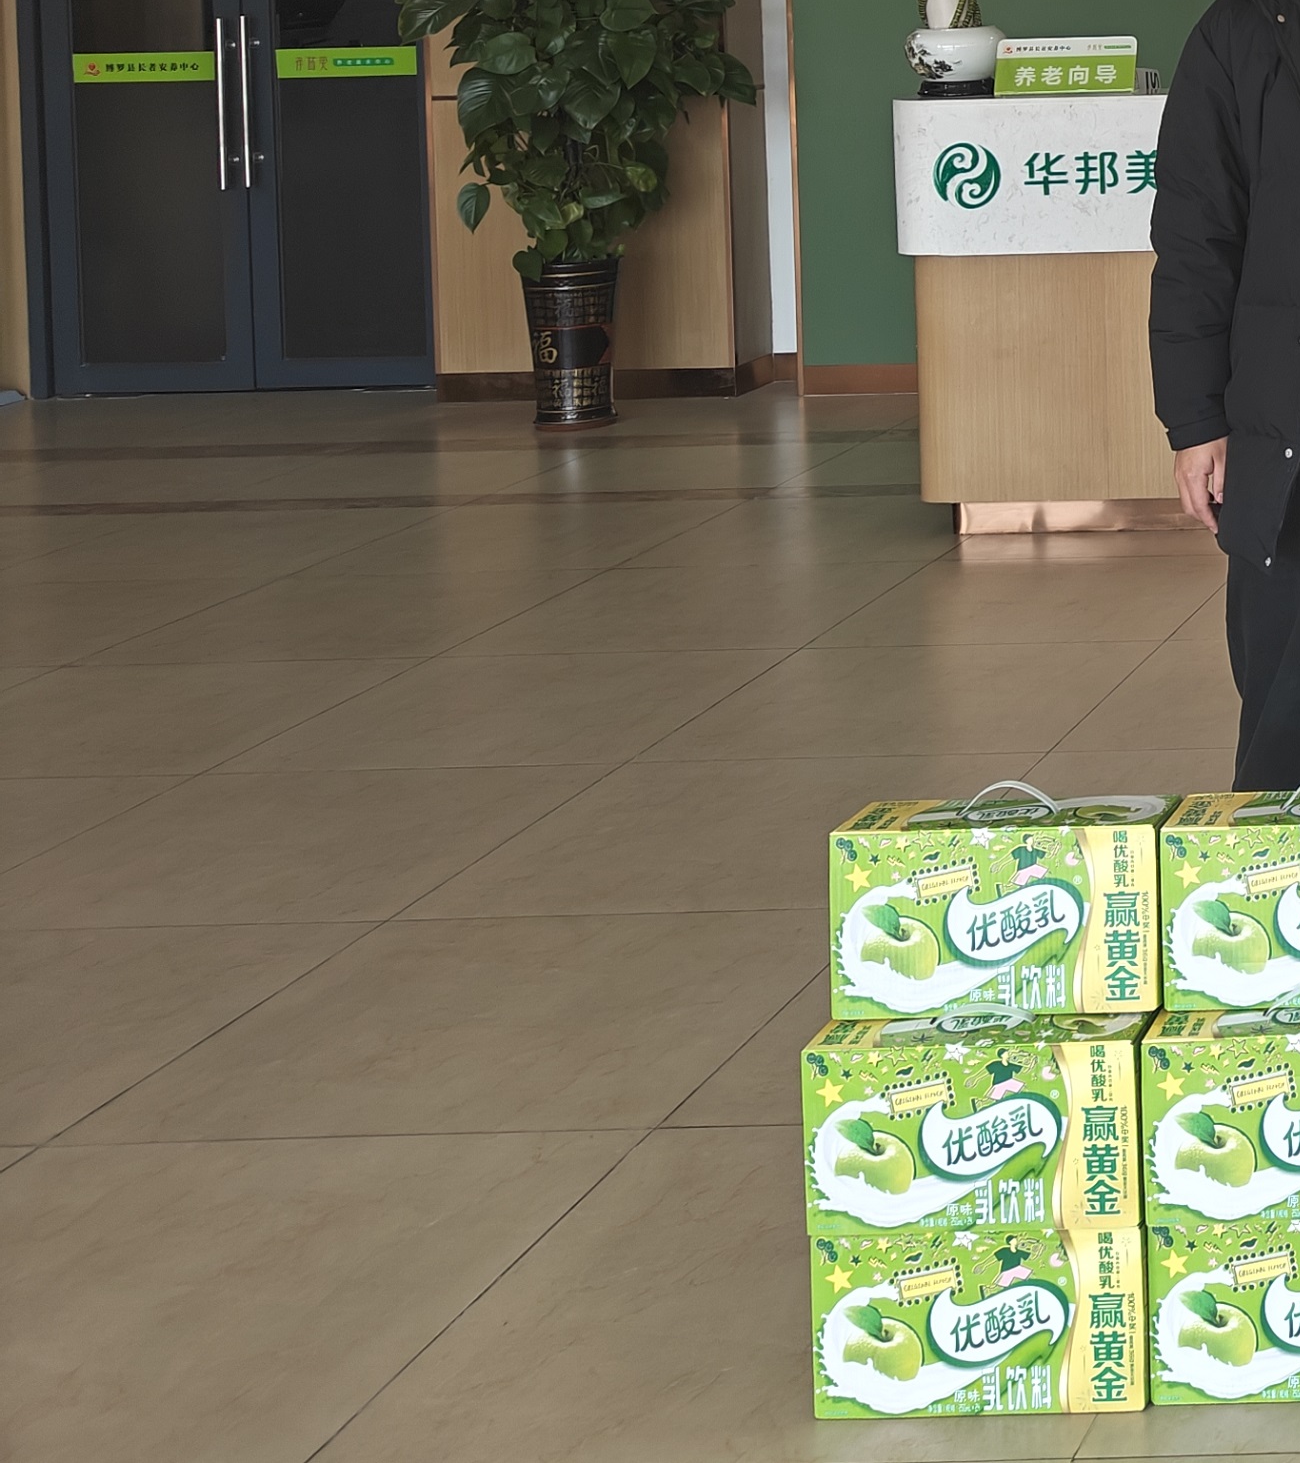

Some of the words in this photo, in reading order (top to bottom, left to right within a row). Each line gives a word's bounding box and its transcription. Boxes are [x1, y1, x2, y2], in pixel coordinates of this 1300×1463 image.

[105, 61, 200, 72] 博罗县长者安养中心
[1014, 65, 1117, 87] 养老向导
[1024, 149, 1158, 195] 华邦美
[1113, 831, 1129, 888] 喝优酸乳
[967, 889, 1065, 952] 优酸乳
[1104, 892, 1140, 1002] 赢黄金
[970, 989, 995, 1001] 原味
[997, 965, 1065, 1009] 乳饮料
[1090, 1046, 1107, 1103] 喝优酸乳
[943, 1104, 1043, 1166] 优酸乳
[1082, 1106, 1121, 1215] 赢黄金
[946, 1204, 973, 1216] 原味
[974, 1179, 1044, 1225] 乳饮料
[1098, 1232, 1115, 1289] 喝优酸乳
[951, 1291, 1050, 1353] 优酸乳
[1089, 1293, 1127, 1403] 赢黄金
[954, 1390, 980, 1403] 原味
[982, 1365, 1051, 1411] 乳饮料
